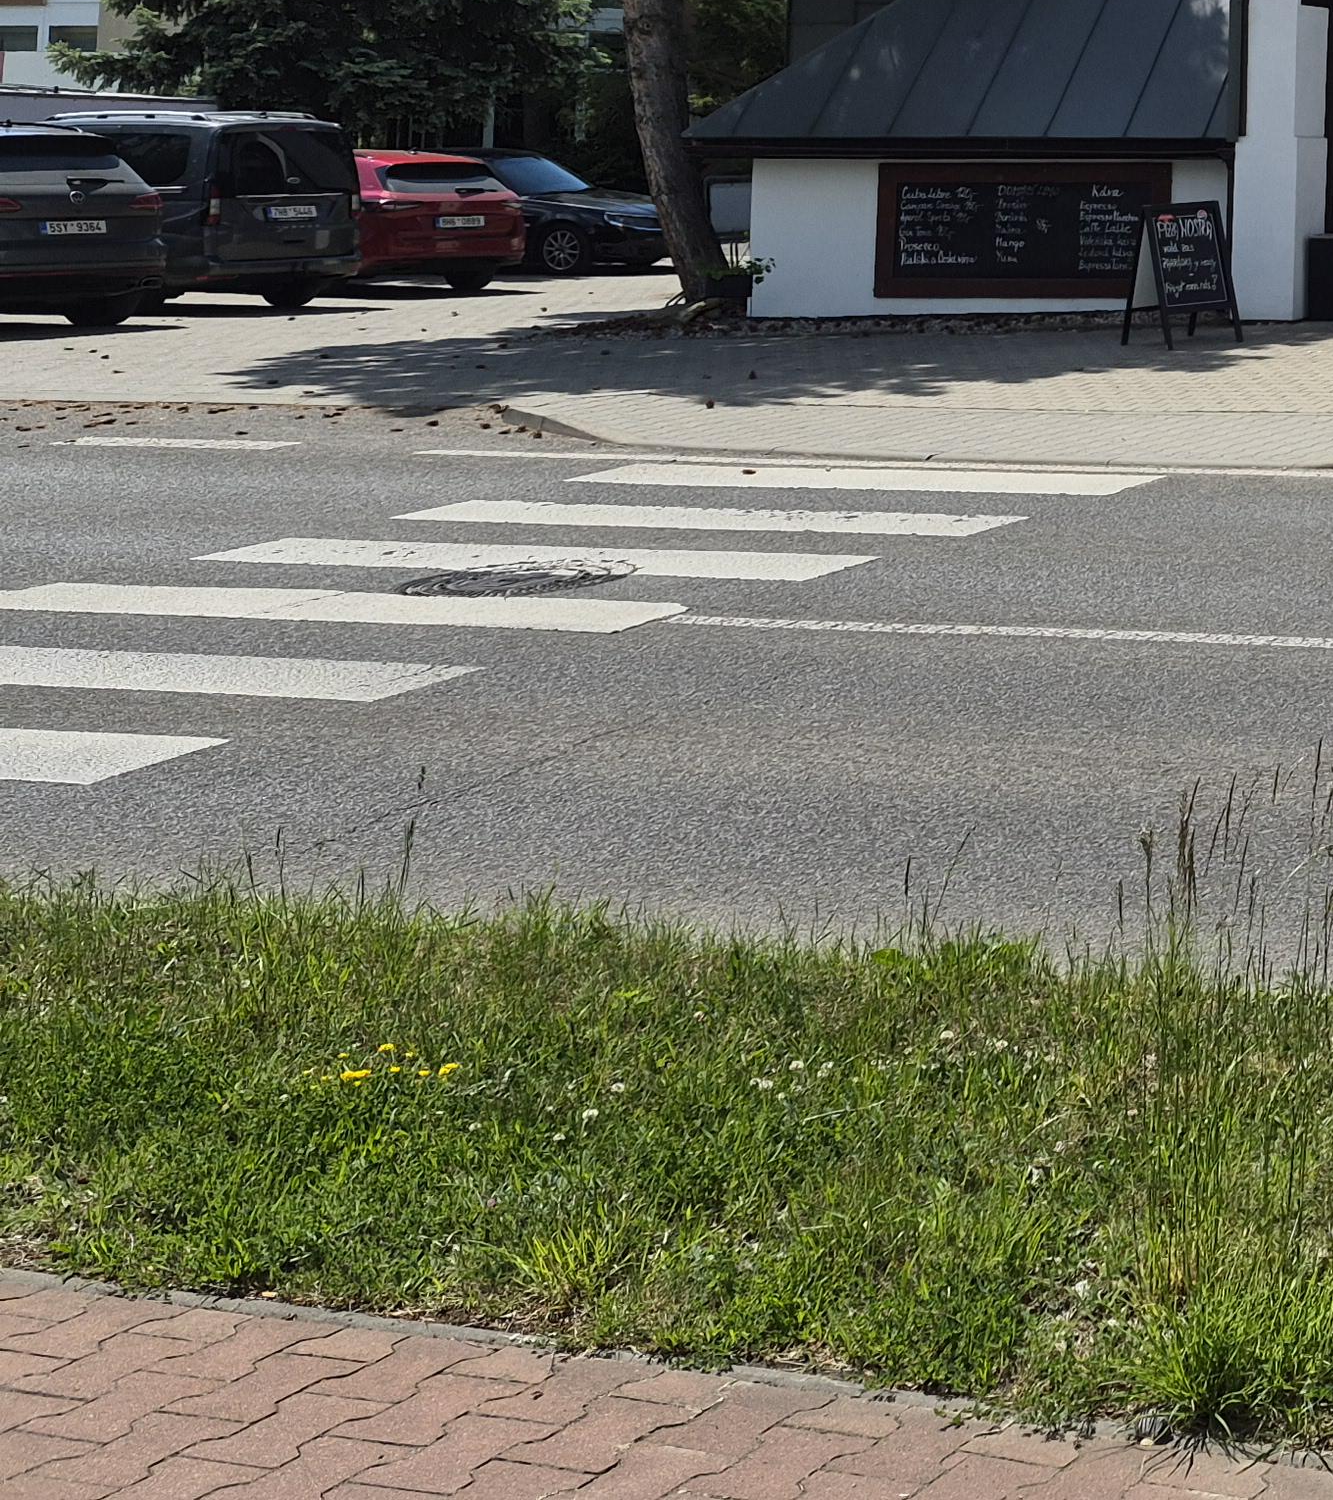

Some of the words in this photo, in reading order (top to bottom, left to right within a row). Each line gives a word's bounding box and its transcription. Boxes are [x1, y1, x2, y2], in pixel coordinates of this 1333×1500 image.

[49, 222, 68, 233] 5SY
[76, 222, 102, 232] 9364
[1179, 218, 1213, 240] NOSTRA
[899, 236, 940, 251] Prosecco
[996, 236, 1024, 252] Mango
